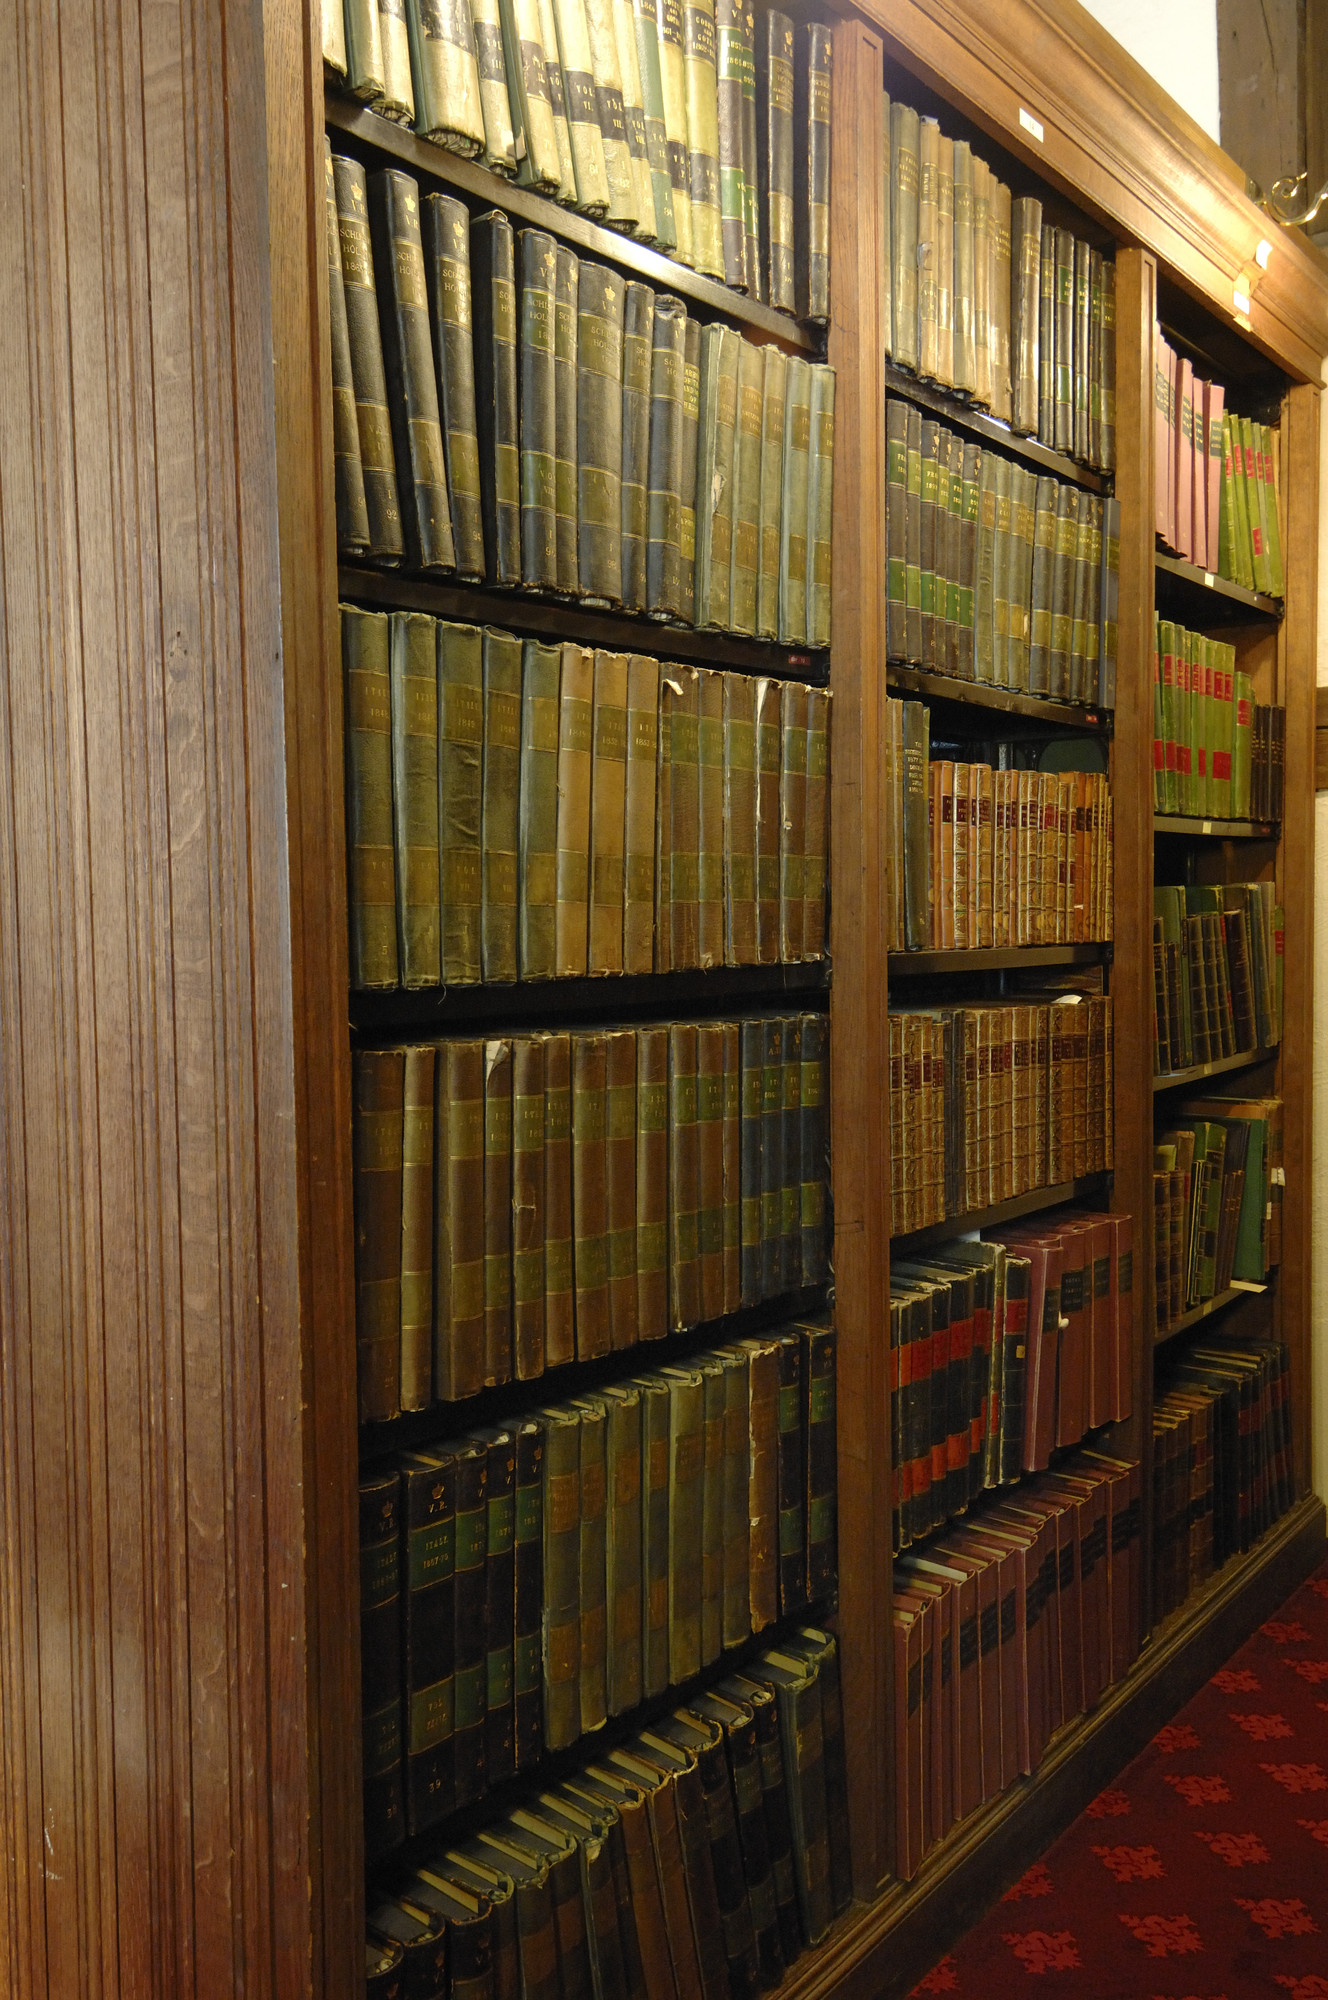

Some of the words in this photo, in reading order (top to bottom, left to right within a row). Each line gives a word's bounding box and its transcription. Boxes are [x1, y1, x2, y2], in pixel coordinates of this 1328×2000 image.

[386, 509, 398, 521] 92
[425, 1535, 449, 1552] ITALY
[429, 1778, 442, 1793] 39
